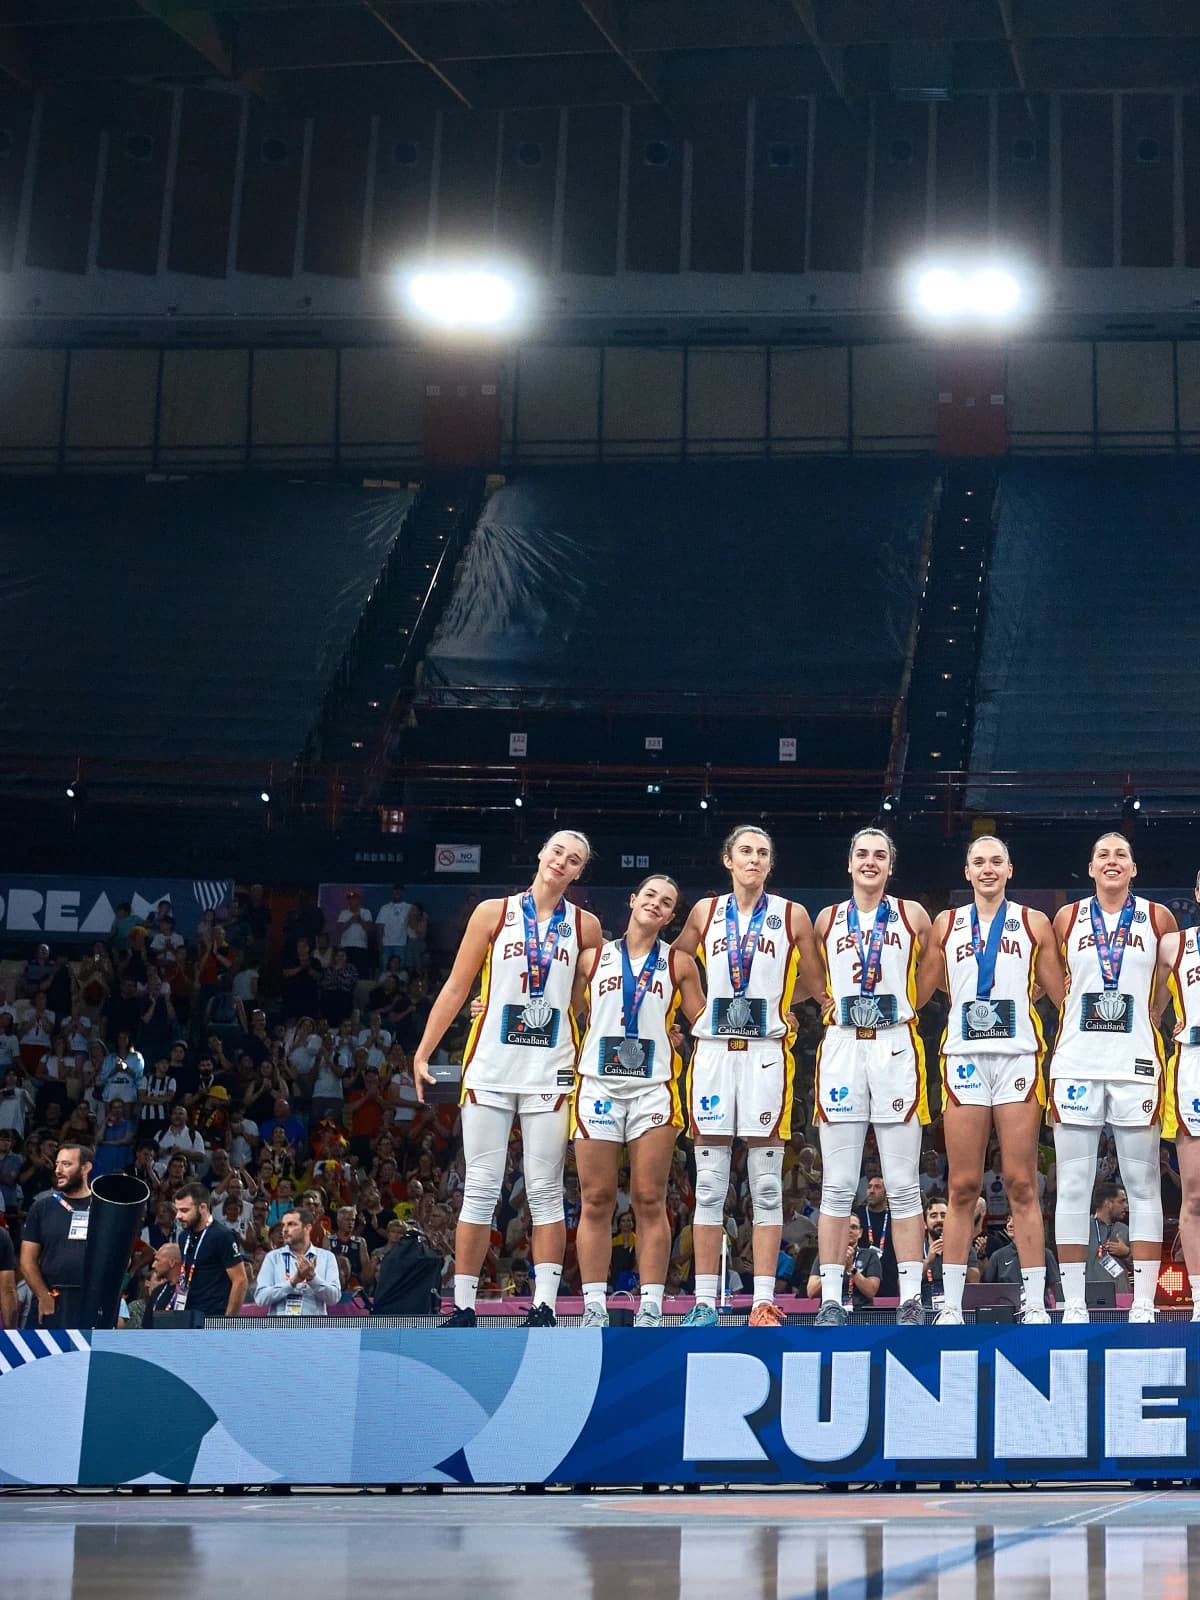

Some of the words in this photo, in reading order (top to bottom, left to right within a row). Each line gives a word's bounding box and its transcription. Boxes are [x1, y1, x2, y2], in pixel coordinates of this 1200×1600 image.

[461, 852, 473, 860] NO
[0, 888, 172, 933] REAM
[712, 934, 776, 958] ESÑA
[957, 937, 1022, 962] ESÑA
[1078, 930, 1145, 952] ESA
[503, 941, 570, 966] ESA
[599, 975, 664, 999] ESA
[717, 1026, 759, 1037] CaixaBank
[969, 1028, 1009, 1038] CaixaBank
[1085, 1020, 1126, 1031] CaixaBank
[507, 1032, 550, 1046] CaixaBank
